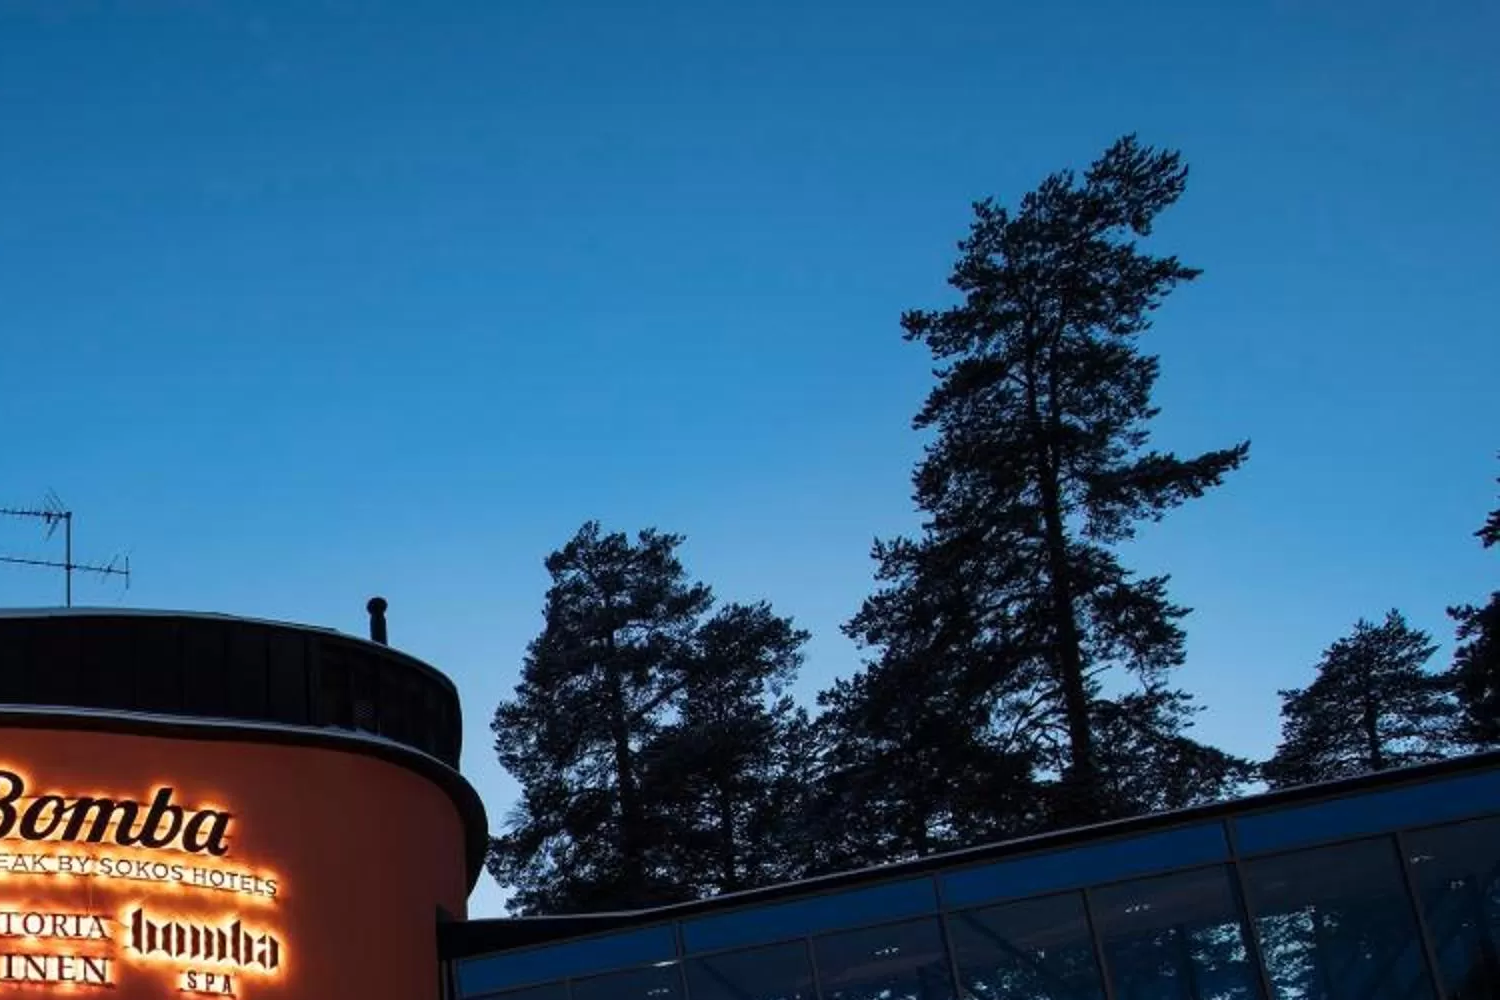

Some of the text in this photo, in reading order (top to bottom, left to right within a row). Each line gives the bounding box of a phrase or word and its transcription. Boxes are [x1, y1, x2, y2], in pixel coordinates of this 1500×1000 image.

[58, 856, 90, 874] BY
[100, 857, 184, 881] SOKOS
[192, 867, 277, 895] HOTELS
[131, 908, 280, 970] bomba
[186, 970, 233, 993] SPA
